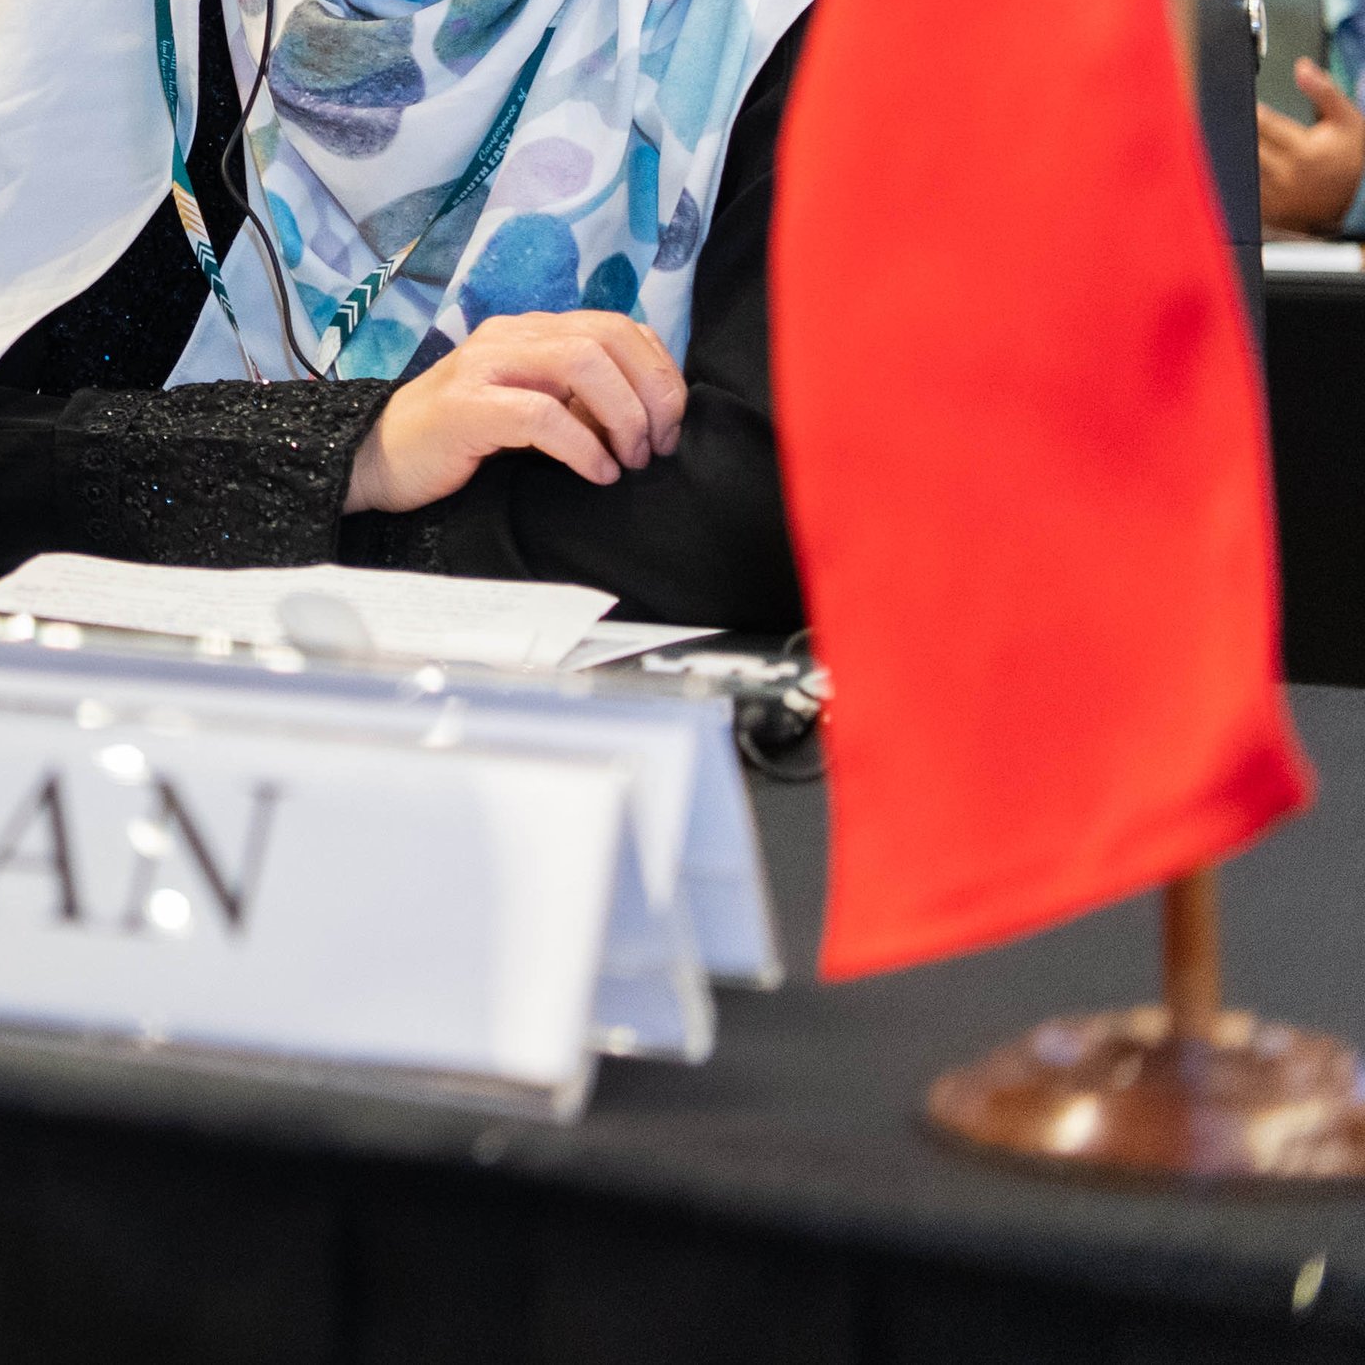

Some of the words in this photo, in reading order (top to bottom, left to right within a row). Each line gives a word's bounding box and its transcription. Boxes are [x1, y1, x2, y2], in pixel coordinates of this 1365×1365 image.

[478, 103, 518, 162] Conference
[517, 87, 529, 102] of
[488, 132, 514, 167] EAST
